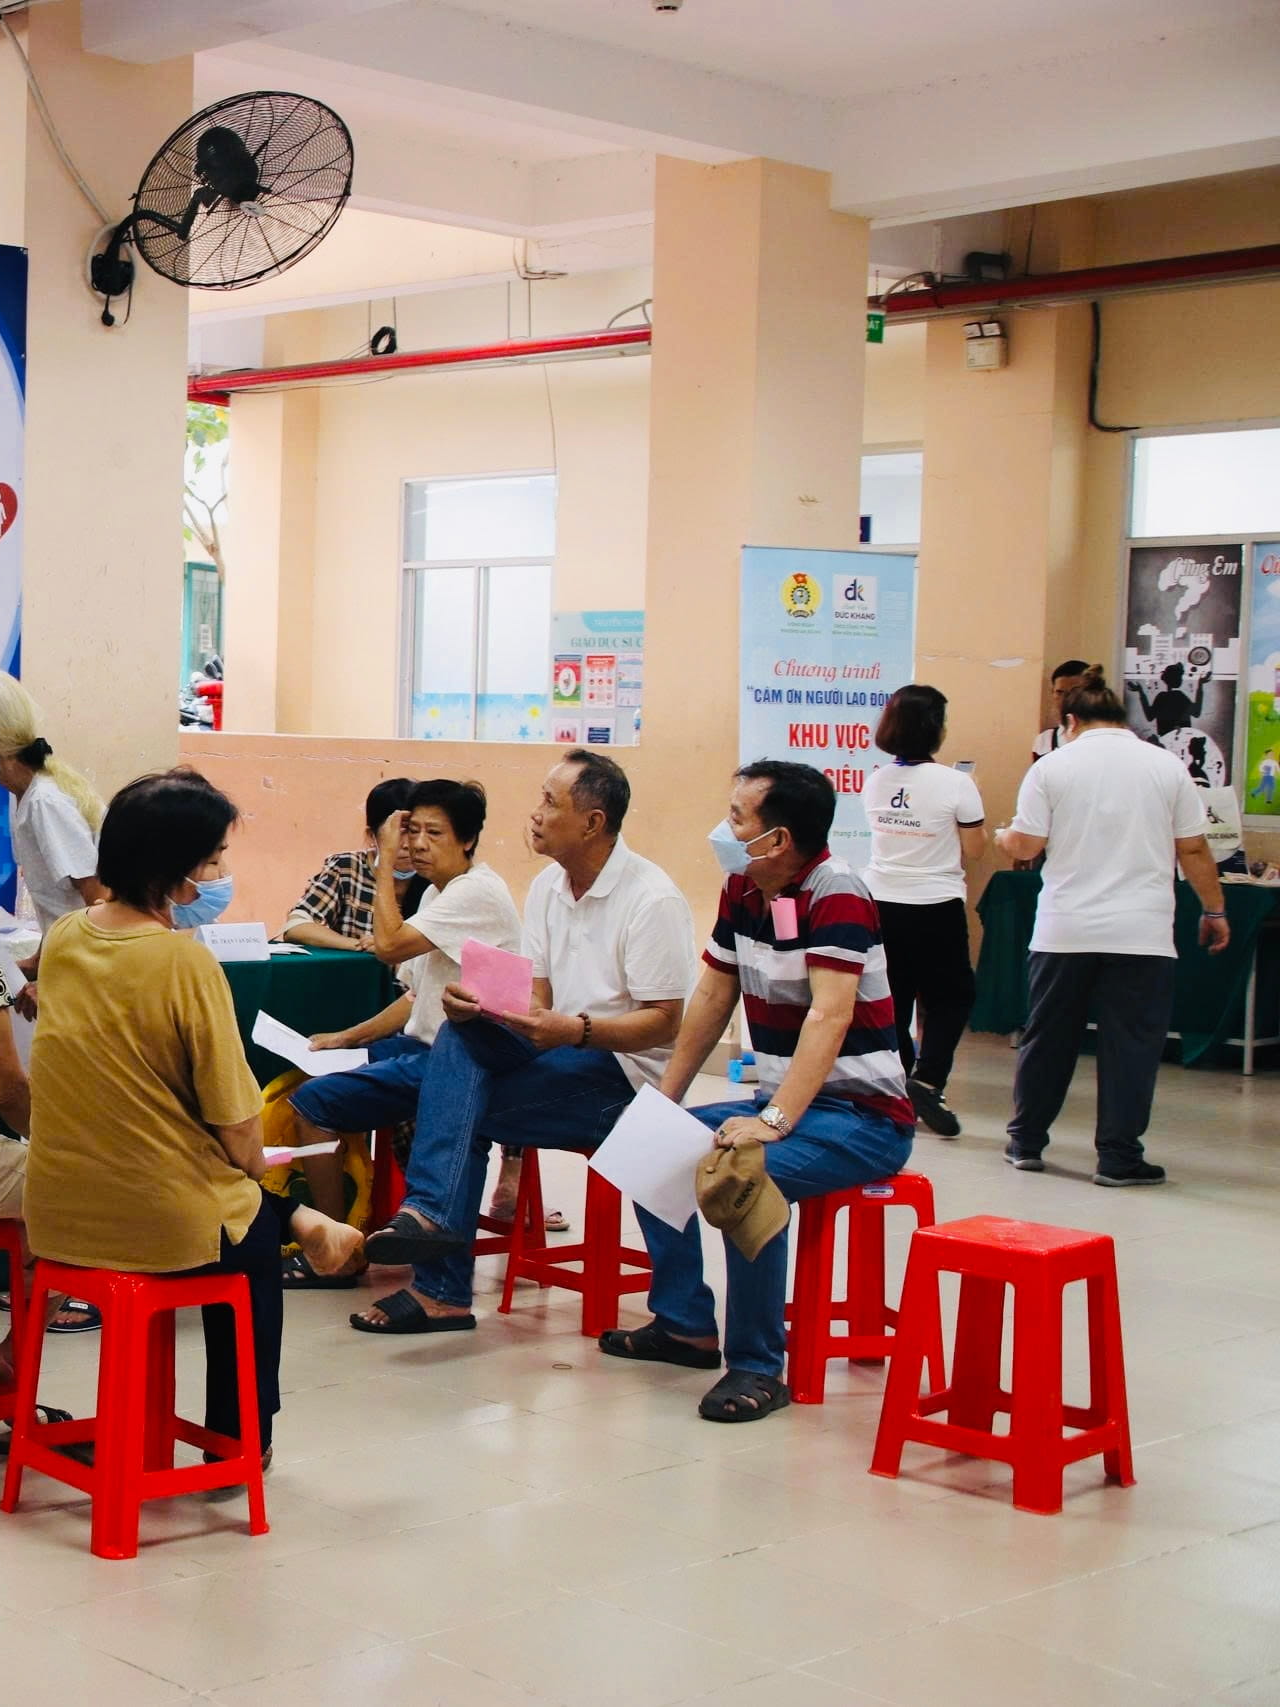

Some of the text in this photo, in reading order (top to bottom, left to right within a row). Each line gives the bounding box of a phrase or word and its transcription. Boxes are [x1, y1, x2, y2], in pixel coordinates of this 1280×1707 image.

[774, 659, 881, 683] Chương trình
[805, 688, 843, 705] NGƯỜI
[846, 692, 866, 706] LAO
[788, 723, 870, 755] KHU VỰC
